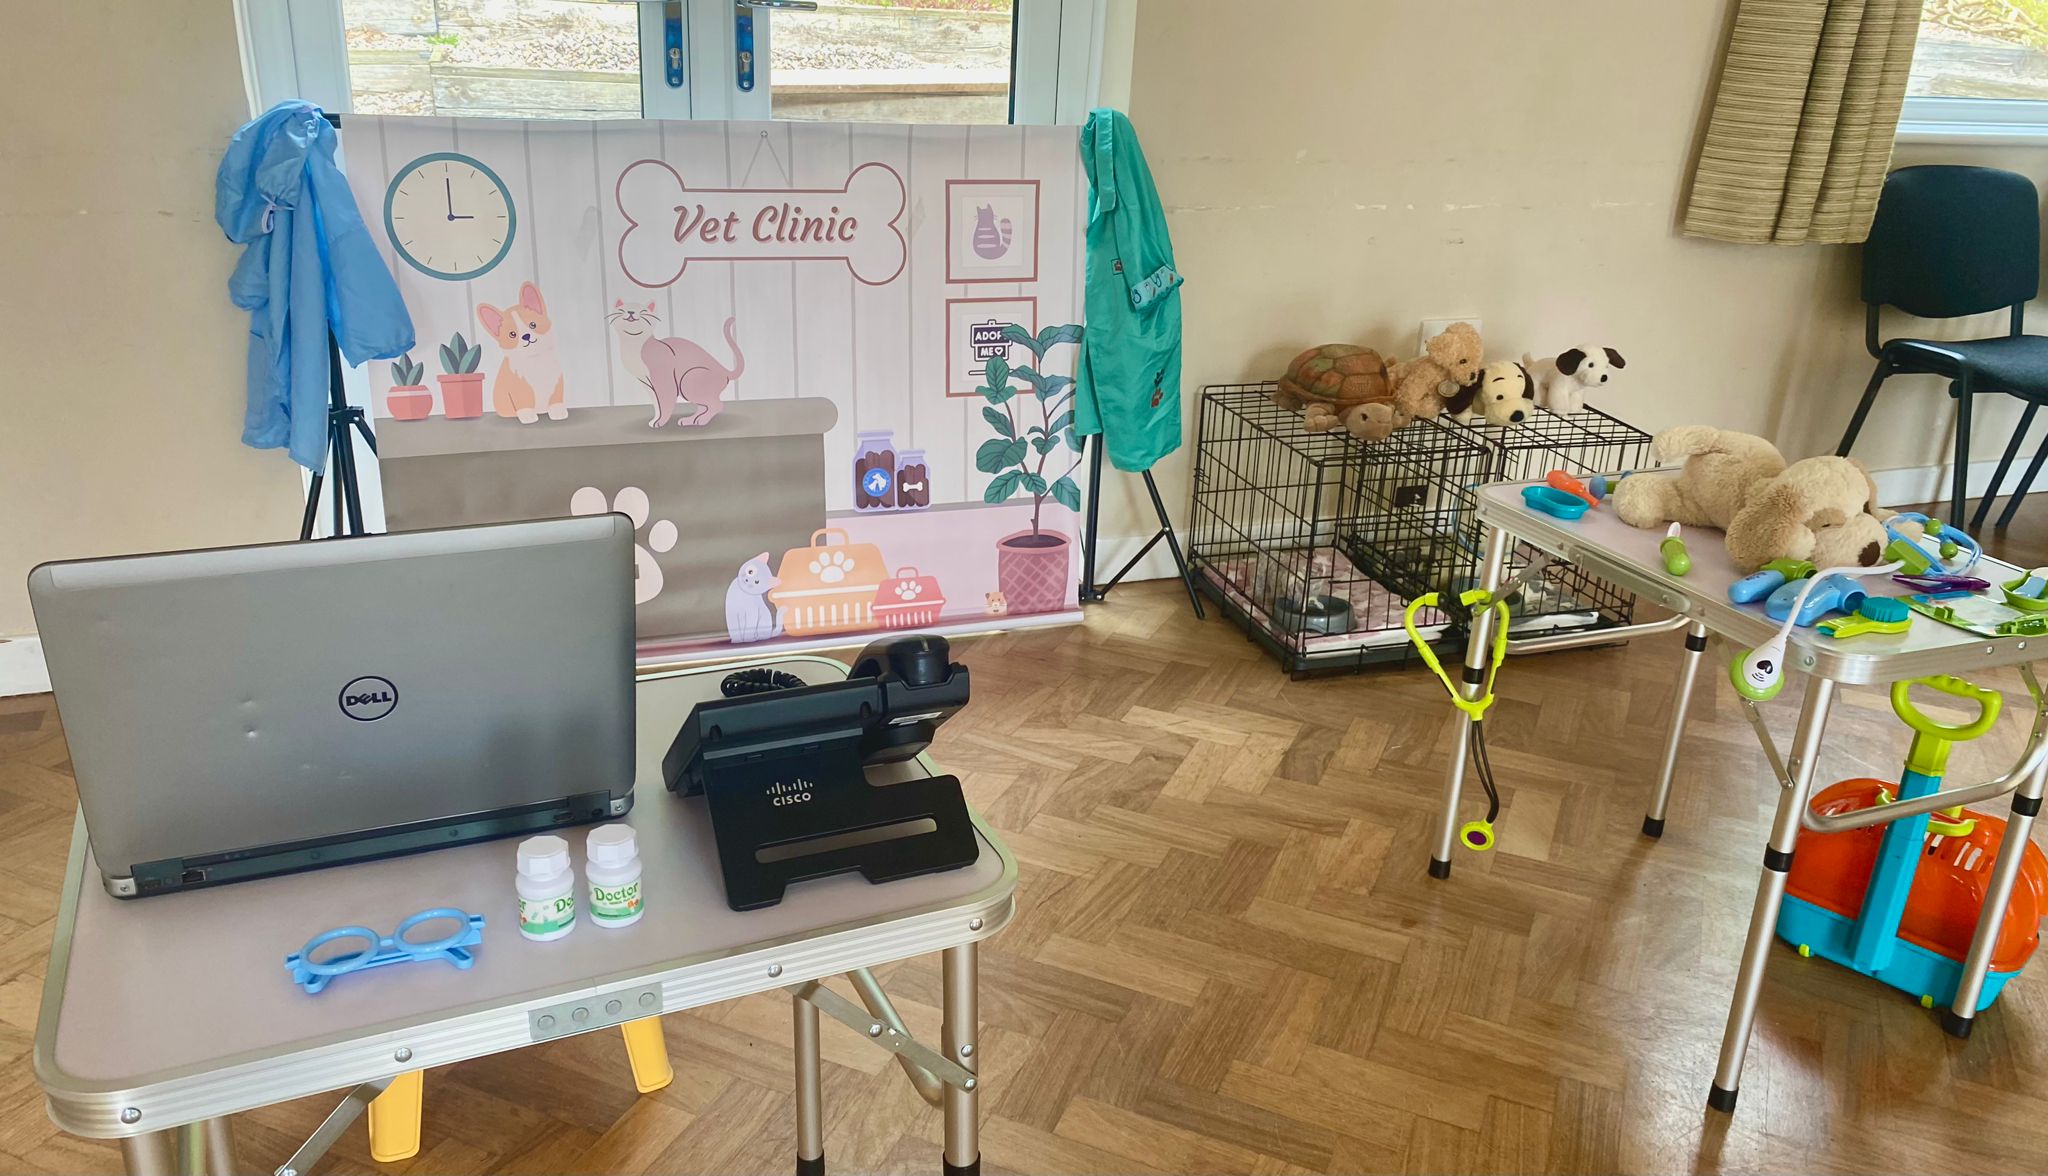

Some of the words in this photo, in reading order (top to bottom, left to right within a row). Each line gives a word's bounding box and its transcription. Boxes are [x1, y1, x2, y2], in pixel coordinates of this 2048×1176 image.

[673, 204, 740, 243] Vet
[752, 202, 858, 243] Clinic
[975, 331, 1003, 341] ADOP
[980, 347, 994, 356] ME
[345, 691, 392, 707] DELL
[773, 792, 812, 806] CISCO
[593, 882, 638, 902] Doctor
